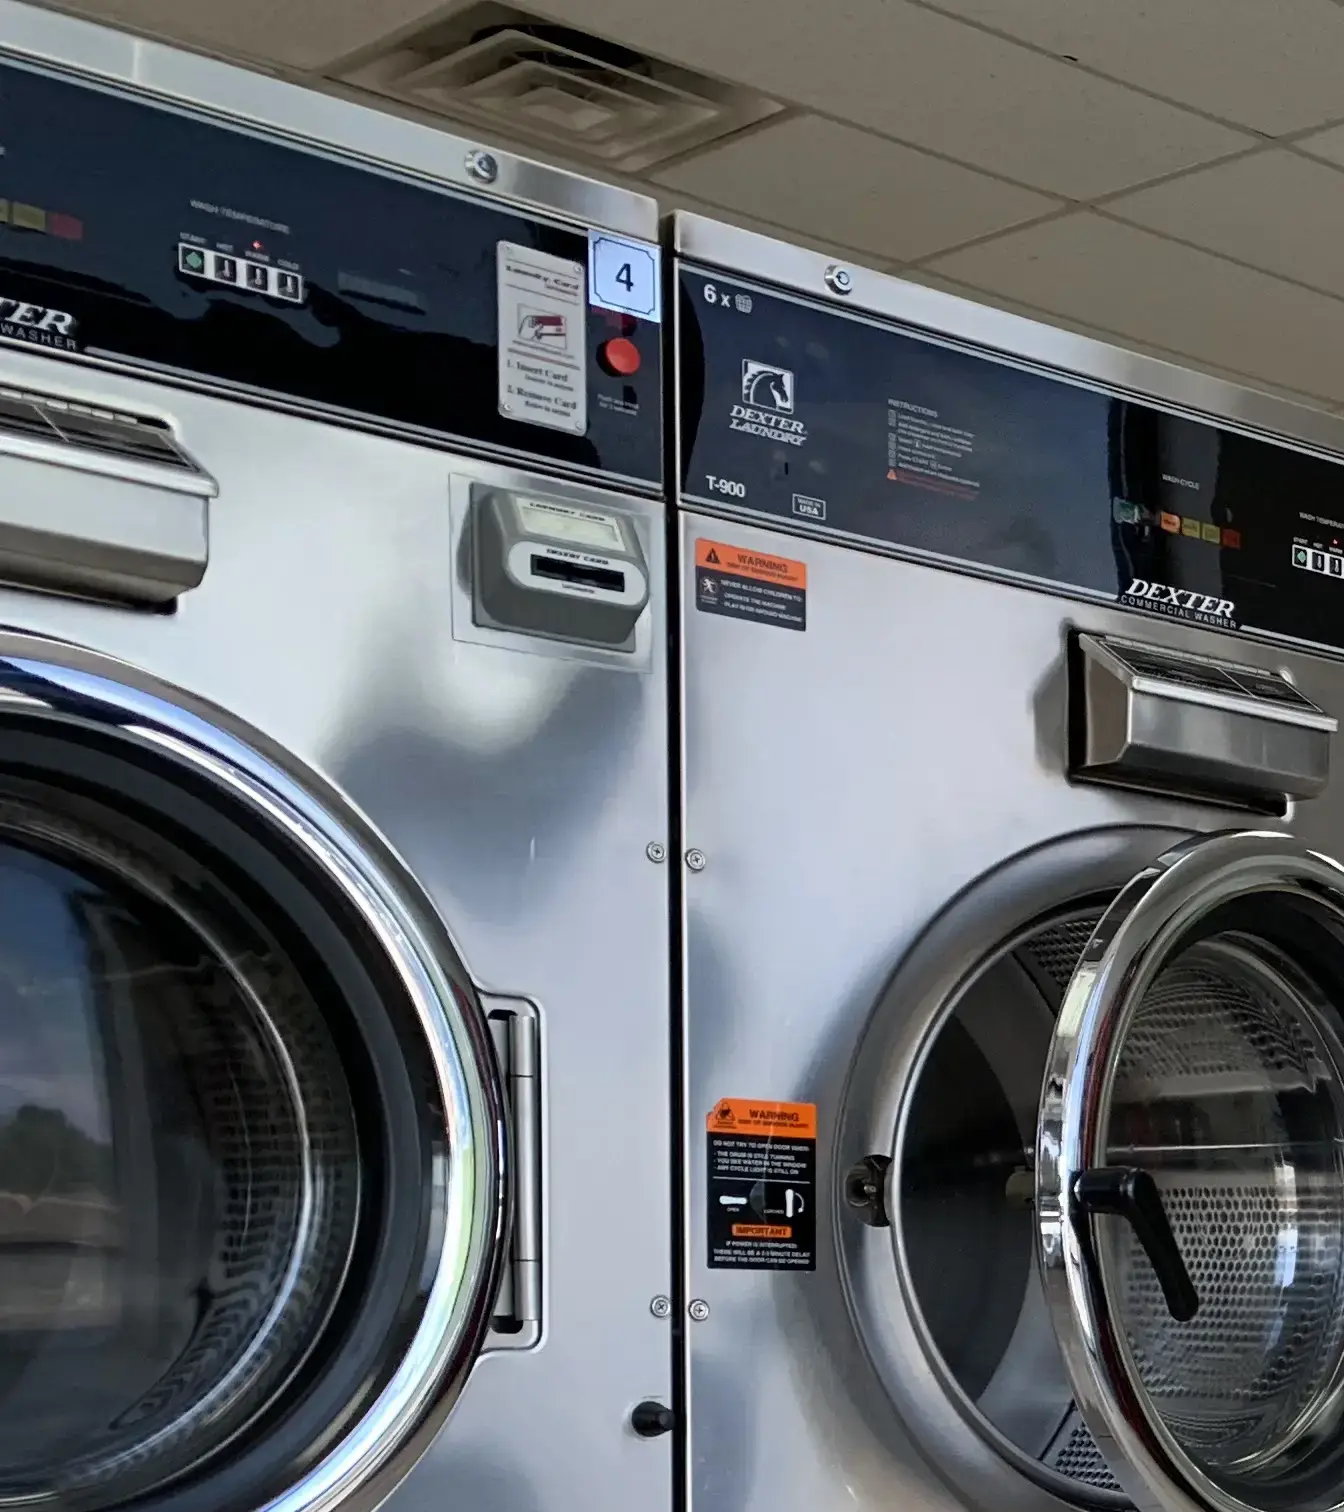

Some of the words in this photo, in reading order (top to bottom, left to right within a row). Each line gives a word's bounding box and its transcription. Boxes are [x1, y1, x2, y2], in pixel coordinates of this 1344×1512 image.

[615, 262, 635, 292] 4
[703, 283, 718, 304] 6
[0, 322, 77, 352] WASHER
[516, 361, 543, 376] Insert
[545, 369, 569, 382] Card
[516, 386, 552, 402] Remove
[554, 396, 577, 410] Card
[888, 398, 939, 419] INSTRUCTIONS
[730, 404, 806, 435] DEXTER
[729, 418, 808, 447] LAUNDRY
[705, 474, 746, 499] T-900
[1181, 479, 1200, 491] CYCLE
[799, 504, 819, 516] USA
[737, 553, 789, 574] WARNING
[1125, 578, 1235, 619] DEXTER
[1121, 594, 1190, 619] COMMERCIAL
[1194, 611, 1237, 629] WASHER
[749, 1108, 800, 1123] WARNING
[735, 1226, 788, 1236] IMPORTANT
